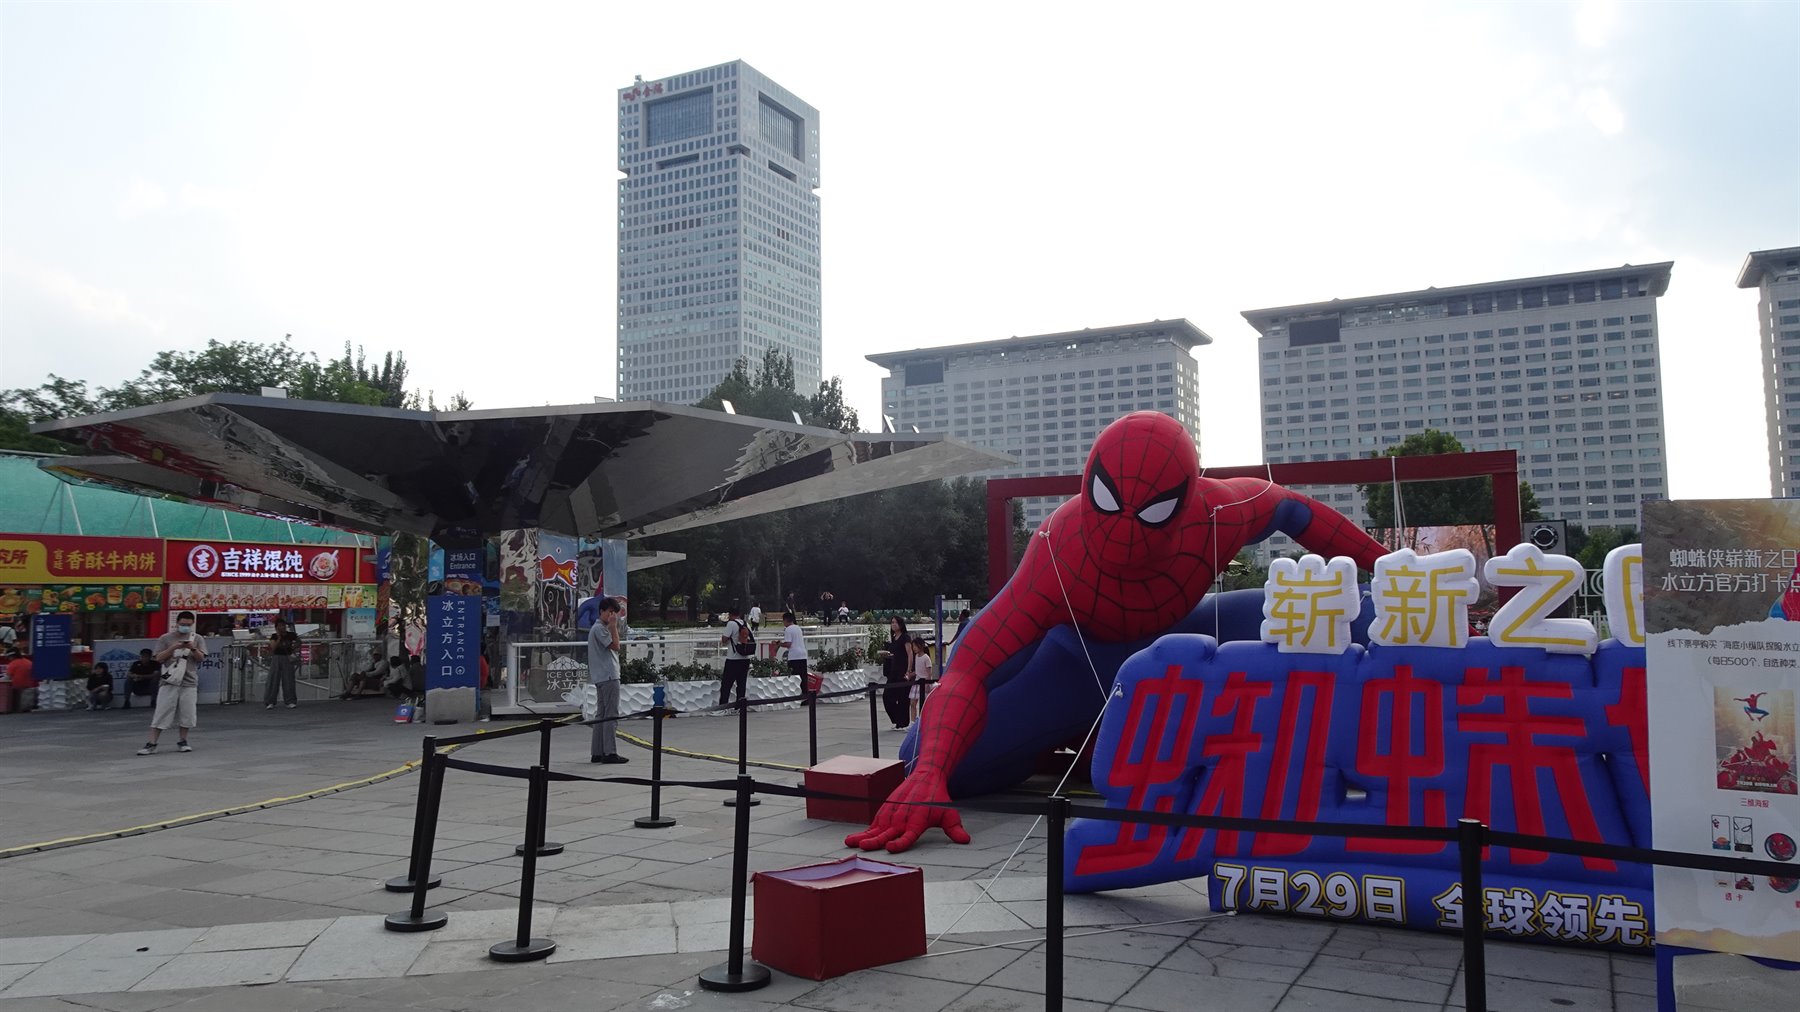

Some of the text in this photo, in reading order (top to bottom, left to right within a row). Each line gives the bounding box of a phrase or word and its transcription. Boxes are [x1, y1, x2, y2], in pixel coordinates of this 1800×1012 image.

[66, 550, 156, 571] 香酥牛肉饼
[196, 550, 210, 571] 吉
[221, 547, 305, 573] 吉祥馄饨
[450, 552, 476, 561] 冰场入口
[1669, 548, 1798, 568] 蜘蛛侠崭新之日
[441, 600, 454, 676] 冰立方入口
[456, 600, 465, 660] ENTRANCE
[564, 670, 588, 678] CUBE
[1214, 863, 1407, 924] 7月29日
